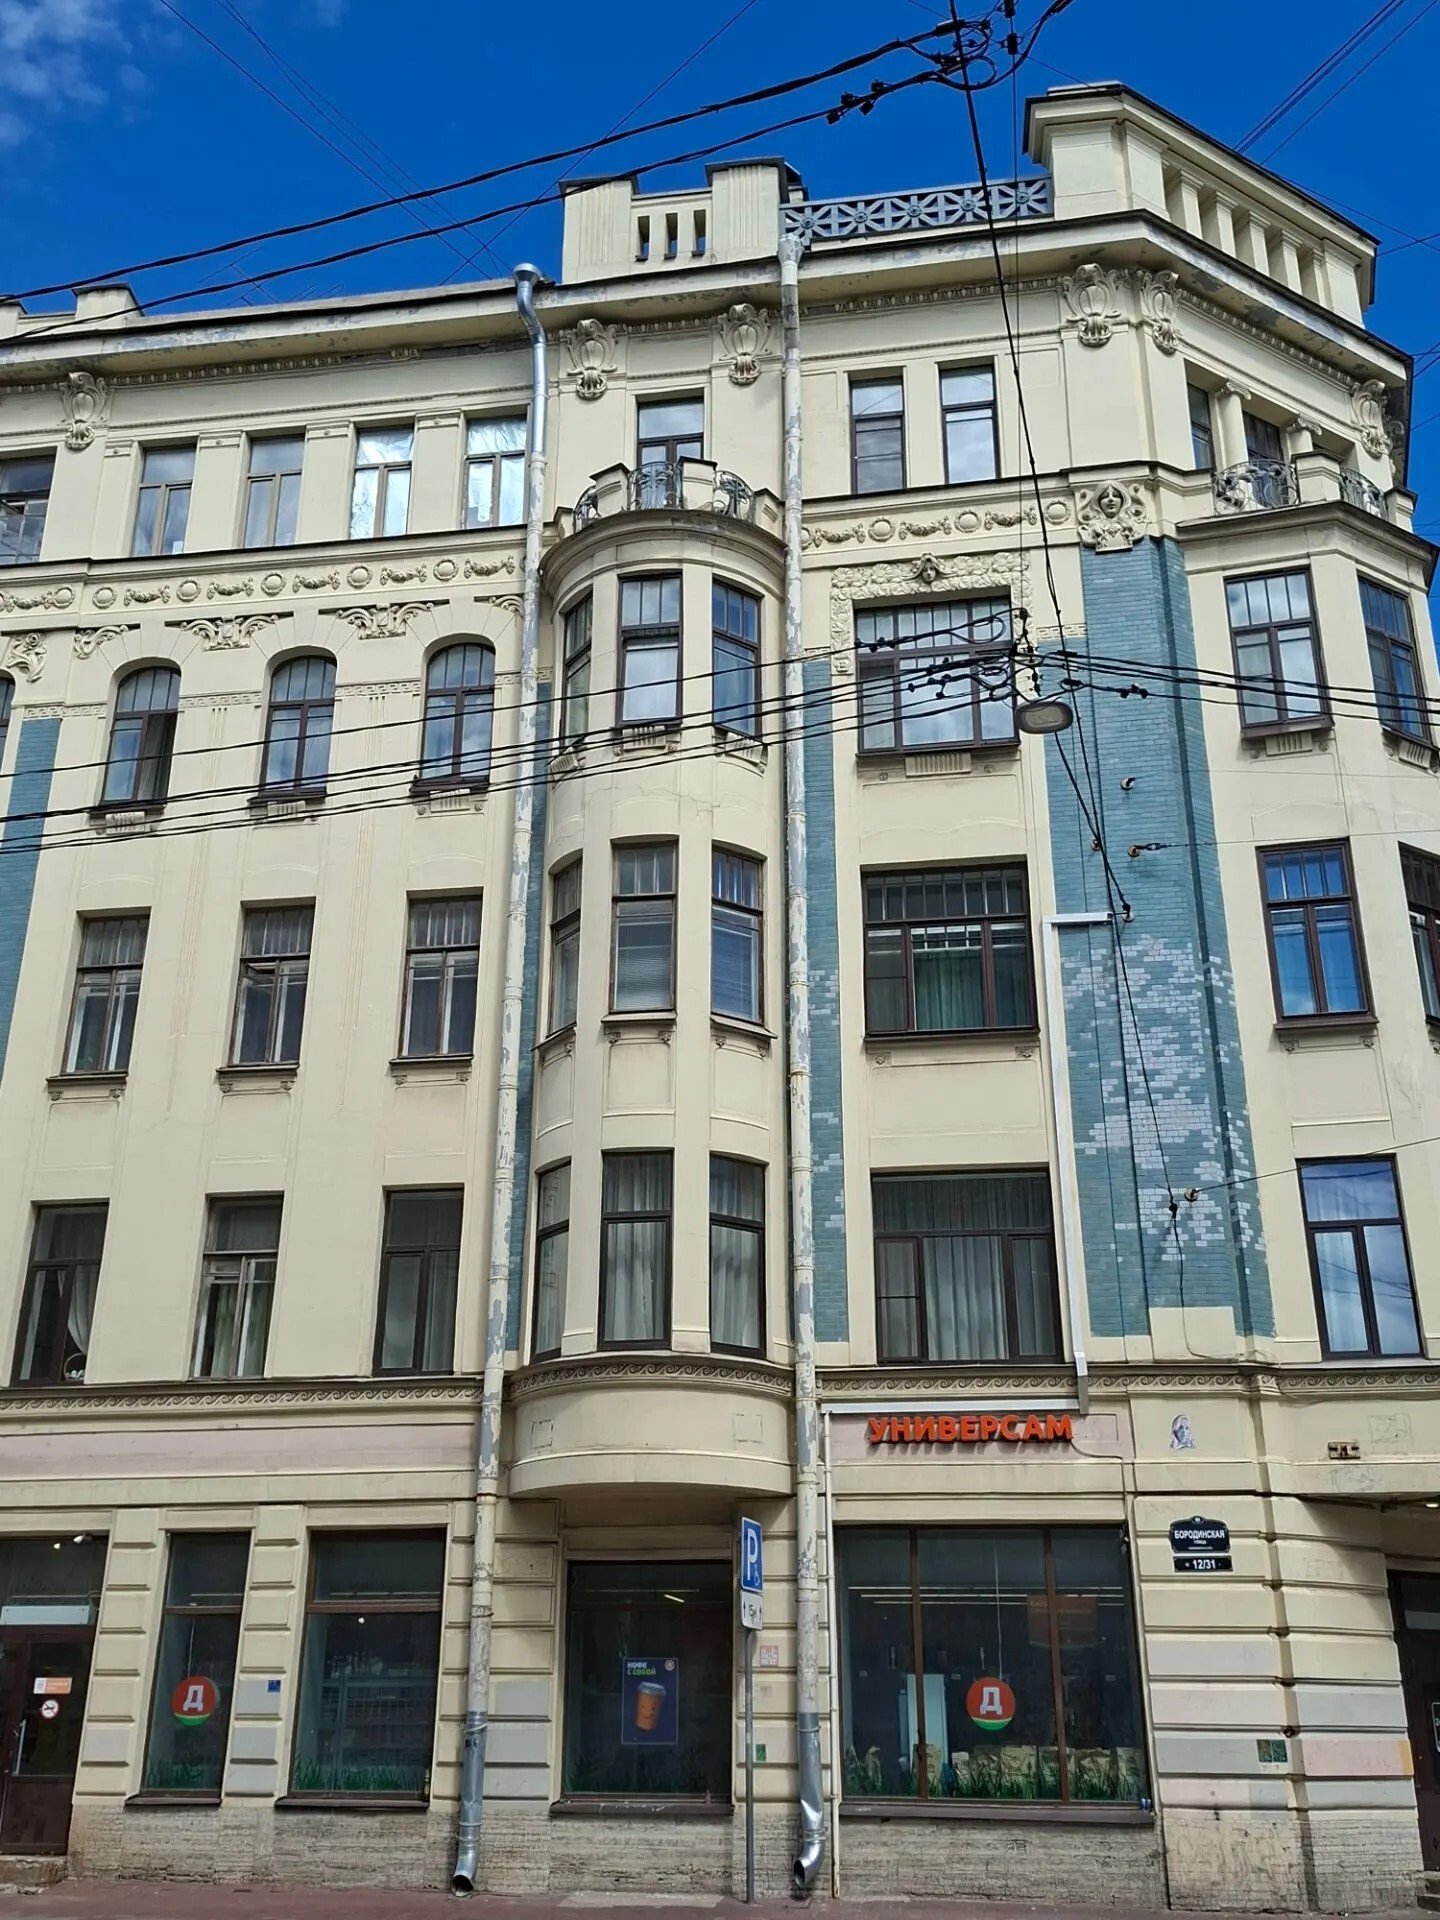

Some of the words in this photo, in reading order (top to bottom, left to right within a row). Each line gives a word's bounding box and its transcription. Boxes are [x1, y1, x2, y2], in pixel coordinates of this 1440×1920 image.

[867, 1414, 1073, 1443] УНИВЕРСАМ
[1174, 1529, 1225, 1540] БОРОДИНСКАЯ
[747, 1528, 758, 1580] P
[1192, 1559, 1216, 1570] 12/31
[182, 1685, 204, 1712] Д
[980, 1687, 1003, 1715] Д
